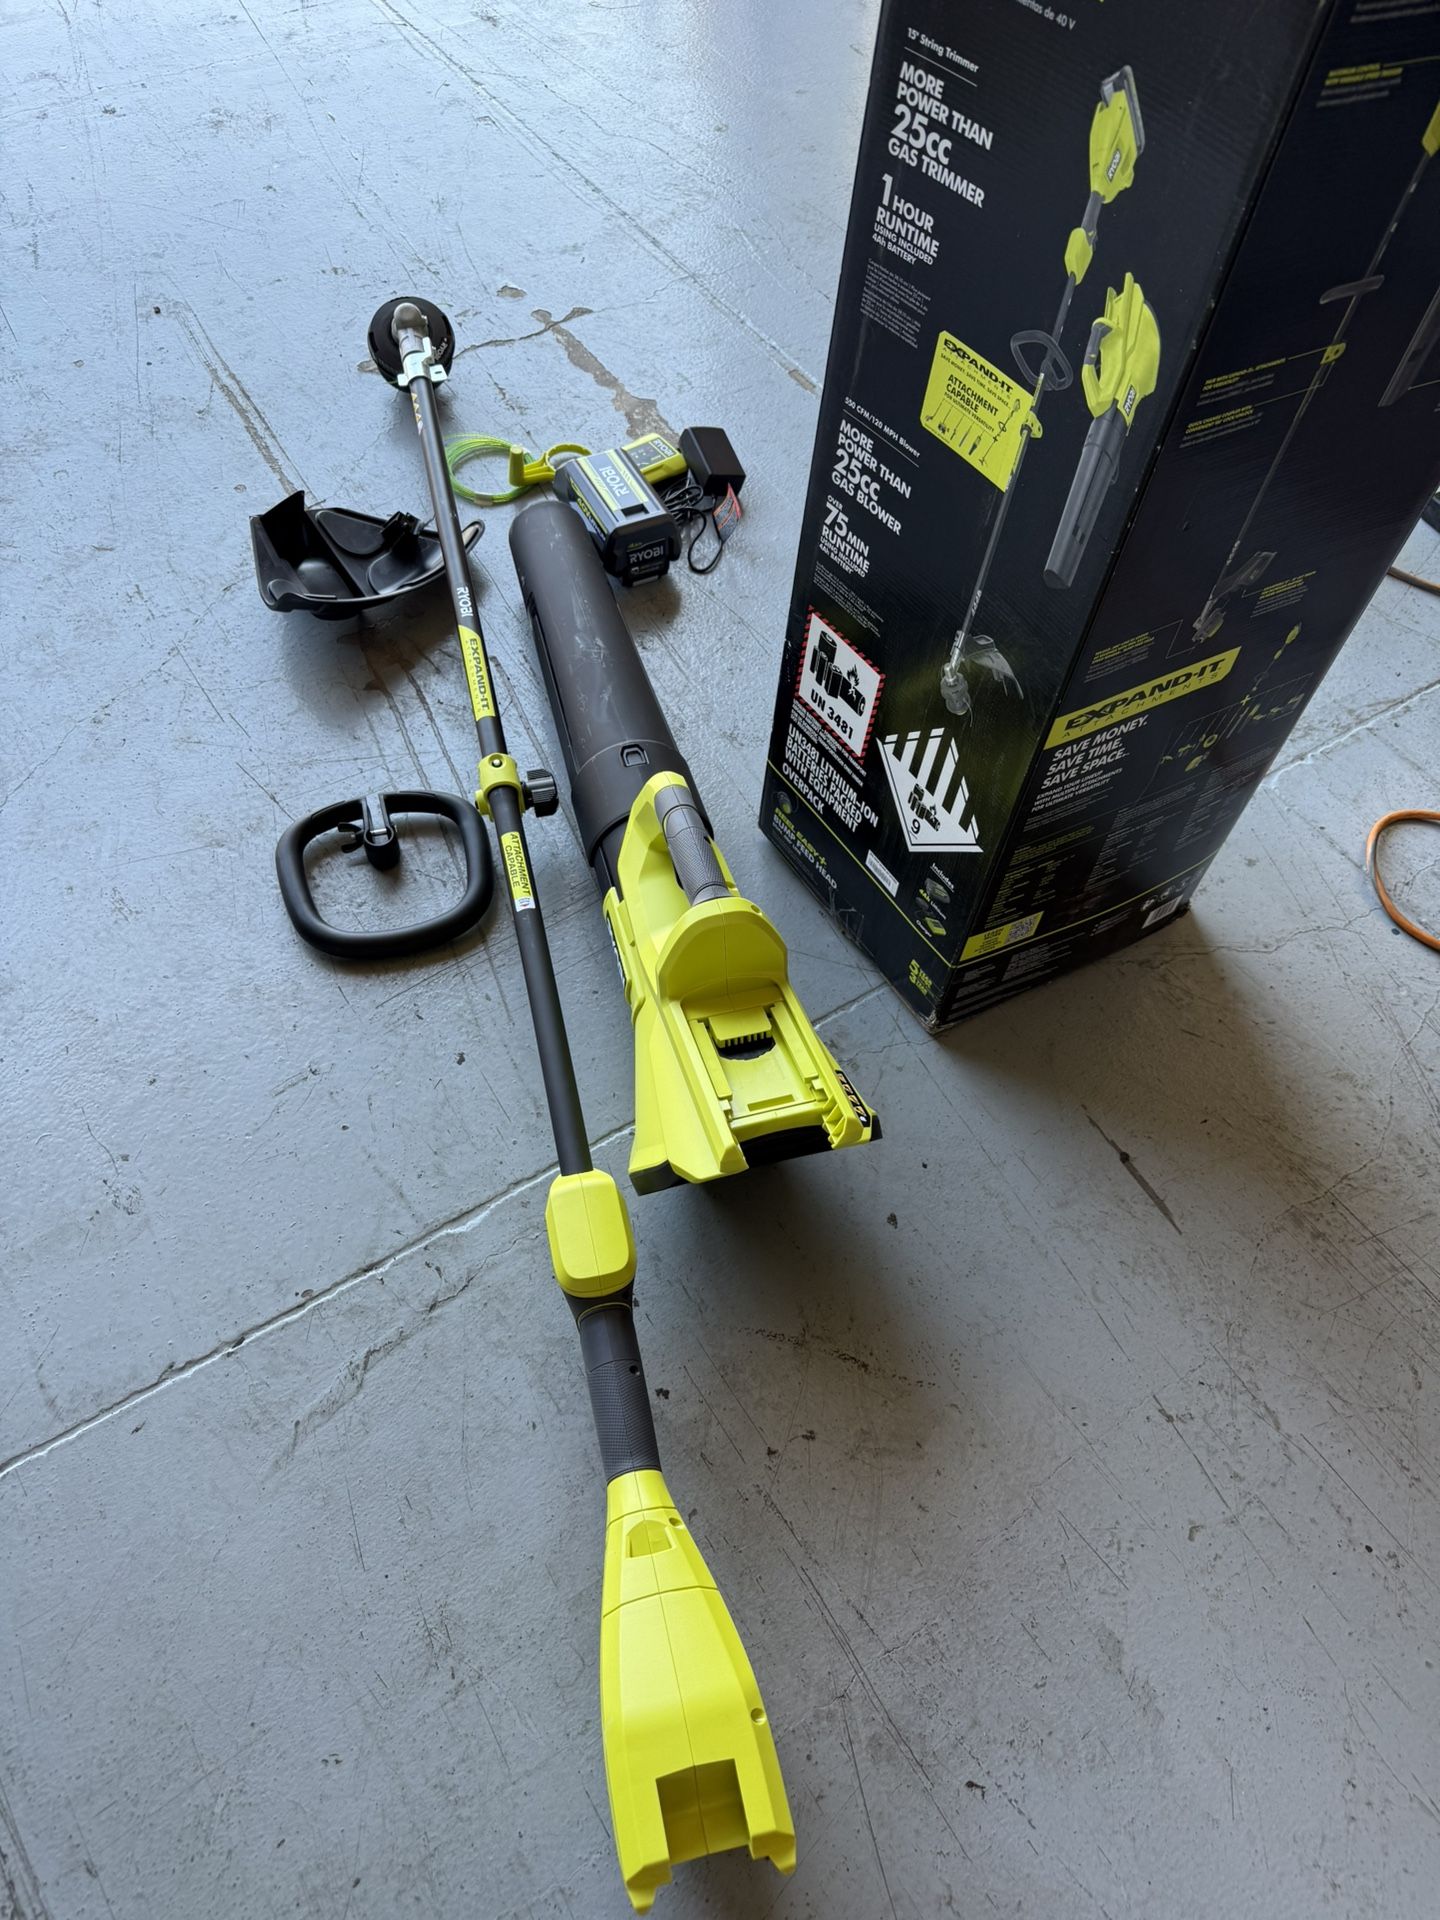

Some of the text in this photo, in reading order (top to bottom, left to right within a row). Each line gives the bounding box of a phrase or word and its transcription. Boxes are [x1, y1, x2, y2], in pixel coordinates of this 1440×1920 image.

[1044, 7, 1055, 20] de
[1056, 14, 1067, 28] 40
[1069, 18, 1077, 30] V
[920, 33, 944, 56] String
[945, 47, 980, 73] Trimmer
[900, 61, 944, 99] MORE
[897, 81, 994, 150] POWER THAN
[887, 136, 985, 208] GAS TRIMMER
[881, 173, 934, 233] 1 HOUR
[871, 232, 917, 265] 4Ah BATTERY
[874, 222, 934, 266] USING INCLUDED
[876, 206, 940, 258] RUNTIME
[946, 383, 980, 414] CAPABLE
[948, 374, 998, 416] ATTACHMENT
[653, 438, 675, 457] RYOBI
[840, 419, 874, 453] MORE
[883, 424, 899, 441] MPH
[899, 437, 920, 458] Blower
[599, 466, 630, 497] RYOBI
[837, 432, 912, 499] POWER THAN
[827, 494, 843, 511] OVER
[831, 471, 902, 536] GAS BLOWER
[821, 524, 870, 574] RUNTIME
[824, 501, 870, 558] 75 MIN
[628, 545, 664, 565] RYOBI
[820, 536, 866, 578] USING INCLUDED
[830, 551, 854, 575] BATTERY
[456, 586, 473, 617] RYOBI
[811, 688, 854, 740] UN 3481
[1061, 673, 1219, 739] ATTACHMENTS
[1046, 737, 1123, 775] SAVE TIME.
[1052, 714, 1149, 761] SAVE MONEY.
[782, 762, 825, 815] OVERPACK
[785, 746, 809, 779] WITH
[808, 776, 858, 833] EQUIPMENT
[786, 735, 829, 787] BATTERIES
[829, 782, 863, 824] PACKED
[788, 722, 820, 762] UN3481
[820, 757, 879, 828] LITHIUM-ION
[1041, 766, 1080, 789] SAVE
[911, 818, 921, 835] 9
[505, 845, 520, 887] CAPABLE
[510, 833, 531, 896] ATTACHMENT
[815, 861, 838, 889] HEAD
[909, 959, 920, 975] 5
